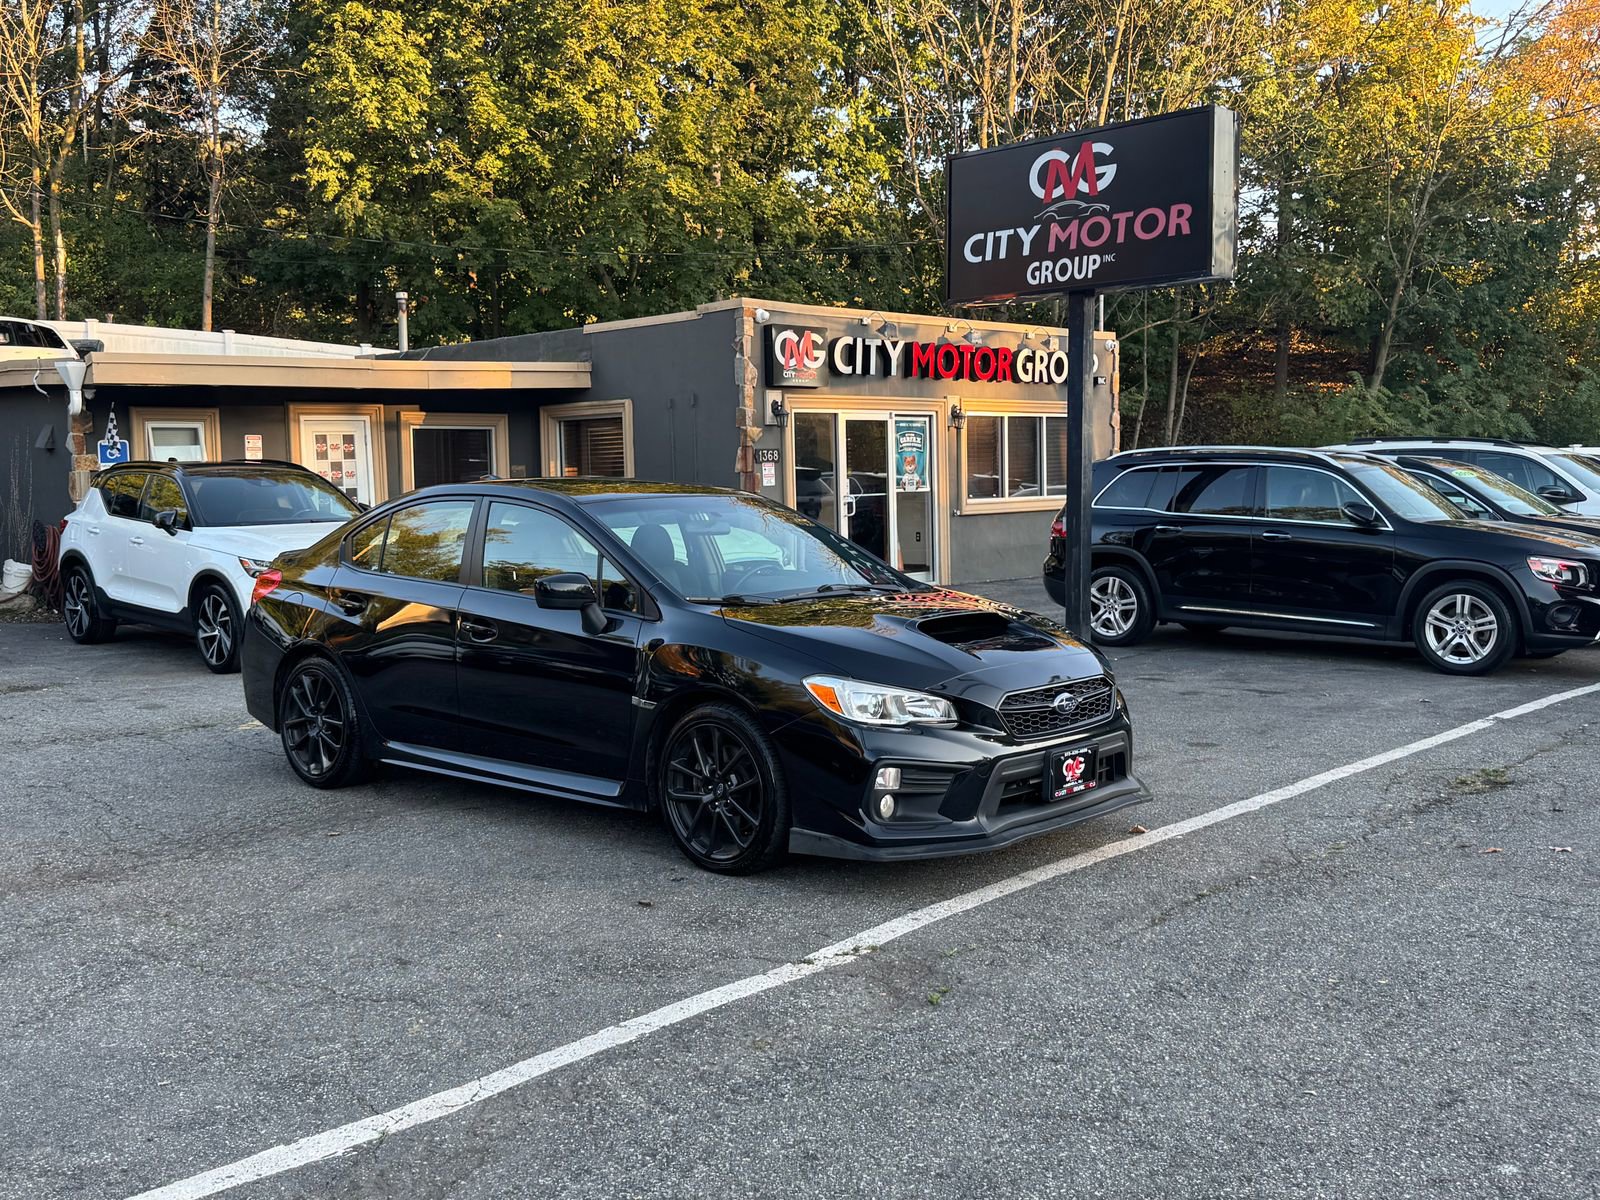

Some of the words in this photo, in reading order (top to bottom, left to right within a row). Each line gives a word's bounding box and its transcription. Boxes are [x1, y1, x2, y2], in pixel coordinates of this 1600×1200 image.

[963, 224, 1041, 263] CITY
[1048, 203, 1193, 252] MOTOR
[1026, 253, 1100, 286] GROUP
[1102, 252, 1116, 264] INC
[833, 336, 905, 377] CITY
[911, 341, 1014, 382] MOTOR
[1016, 347, 1099, 384] GRO
[759, 450, 779, 461] 1368
